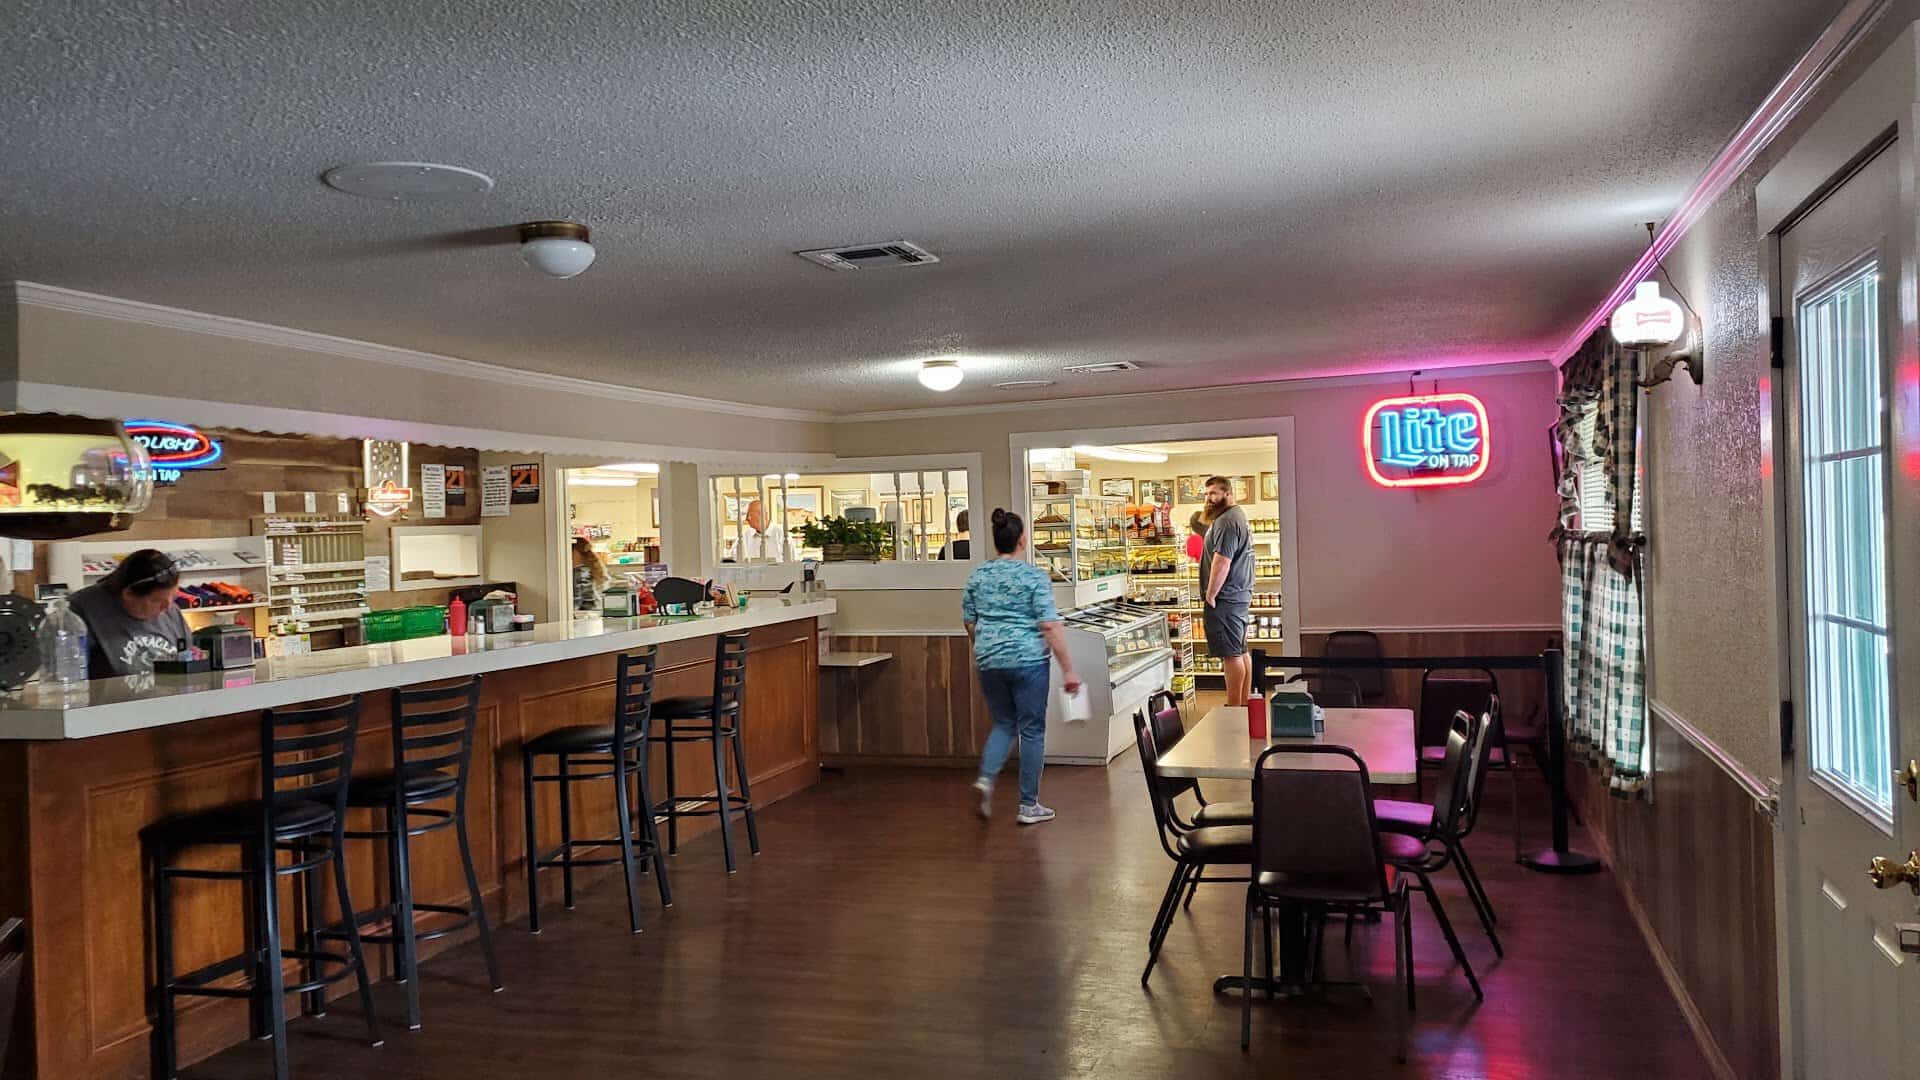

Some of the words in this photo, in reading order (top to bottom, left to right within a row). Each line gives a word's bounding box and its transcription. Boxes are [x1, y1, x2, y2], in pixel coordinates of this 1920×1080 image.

[1379, 408, 1481, 466] Lite
[1428, 454, 1449, 468] ON
[1451, 453, 1480, 467] TAP
[158, 469, 181, 481] TAP
[446, 470, 465, 488] 21
[512, 469, 539, 487] 21
